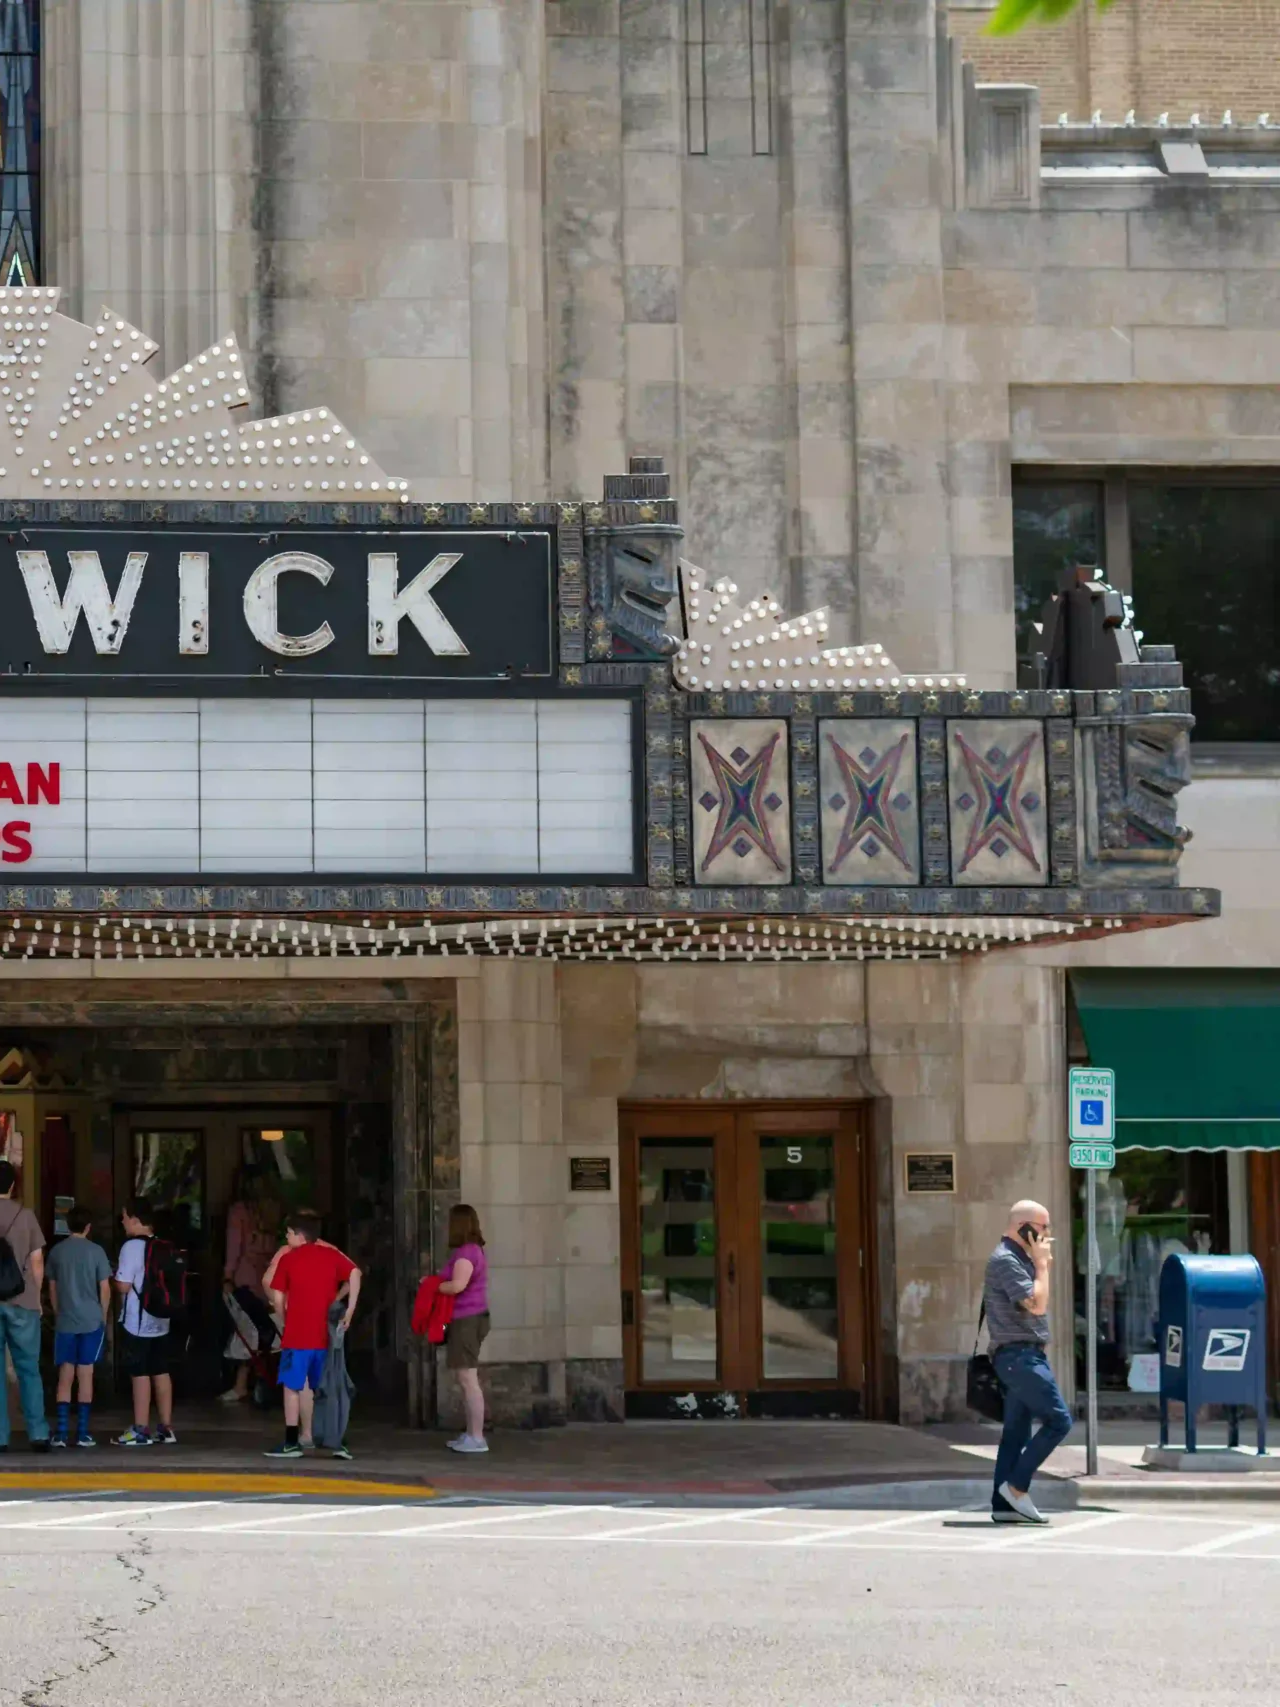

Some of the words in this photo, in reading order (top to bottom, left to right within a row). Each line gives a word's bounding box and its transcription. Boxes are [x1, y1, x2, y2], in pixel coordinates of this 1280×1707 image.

[1072, 1075, 1112, 1085] RESERVED
[1075, 1087, 1108, 1098] PARKING
[787, 1146, 803, 1164] 5
